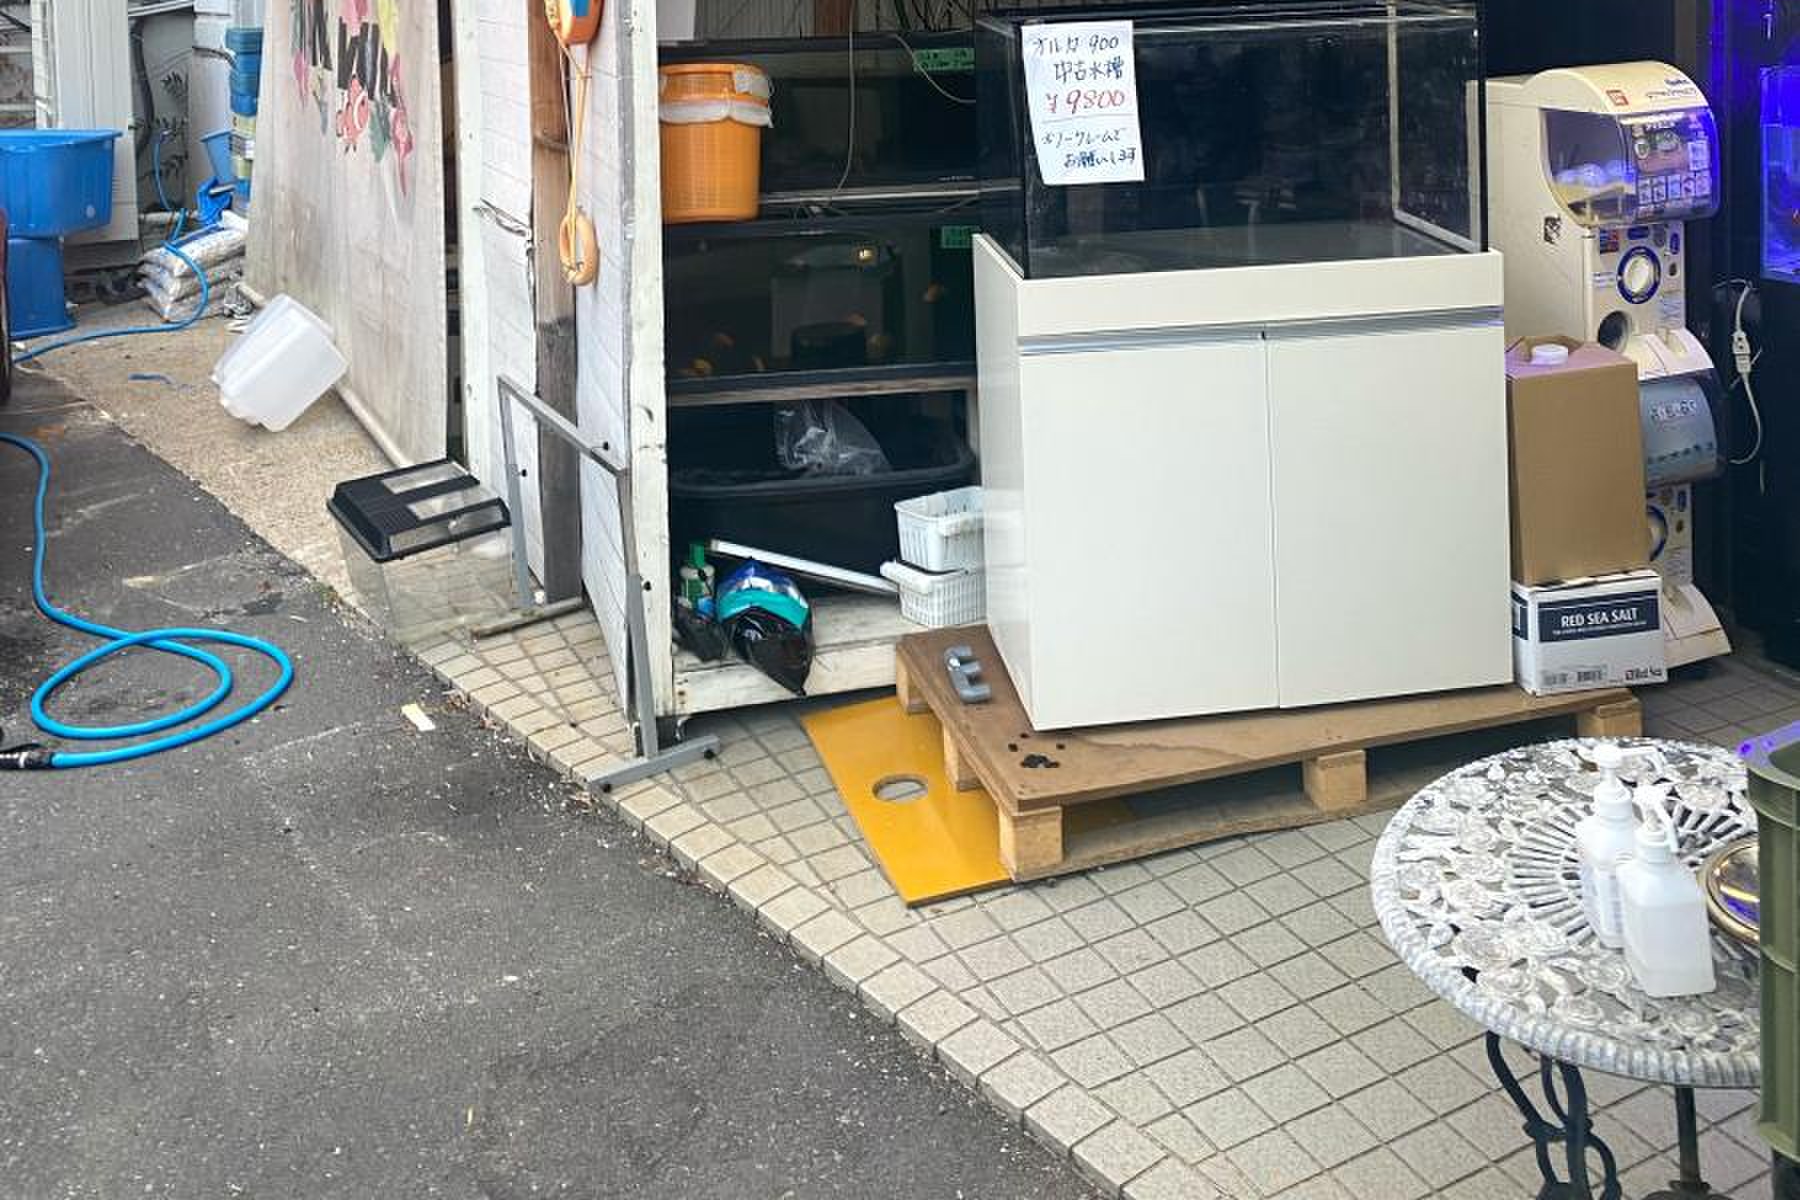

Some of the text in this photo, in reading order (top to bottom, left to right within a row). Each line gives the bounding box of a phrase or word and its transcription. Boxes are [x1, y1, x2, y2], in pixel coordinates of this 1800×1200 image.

[1089, 34, 1119, 53] 900
[1053, 55, 1124, 84] 中古水槽
[1560, 614, 1584, 629] RED
[1587, 610, 1609, 626] SEA
[1611, 607, 1638, 624] SALT
